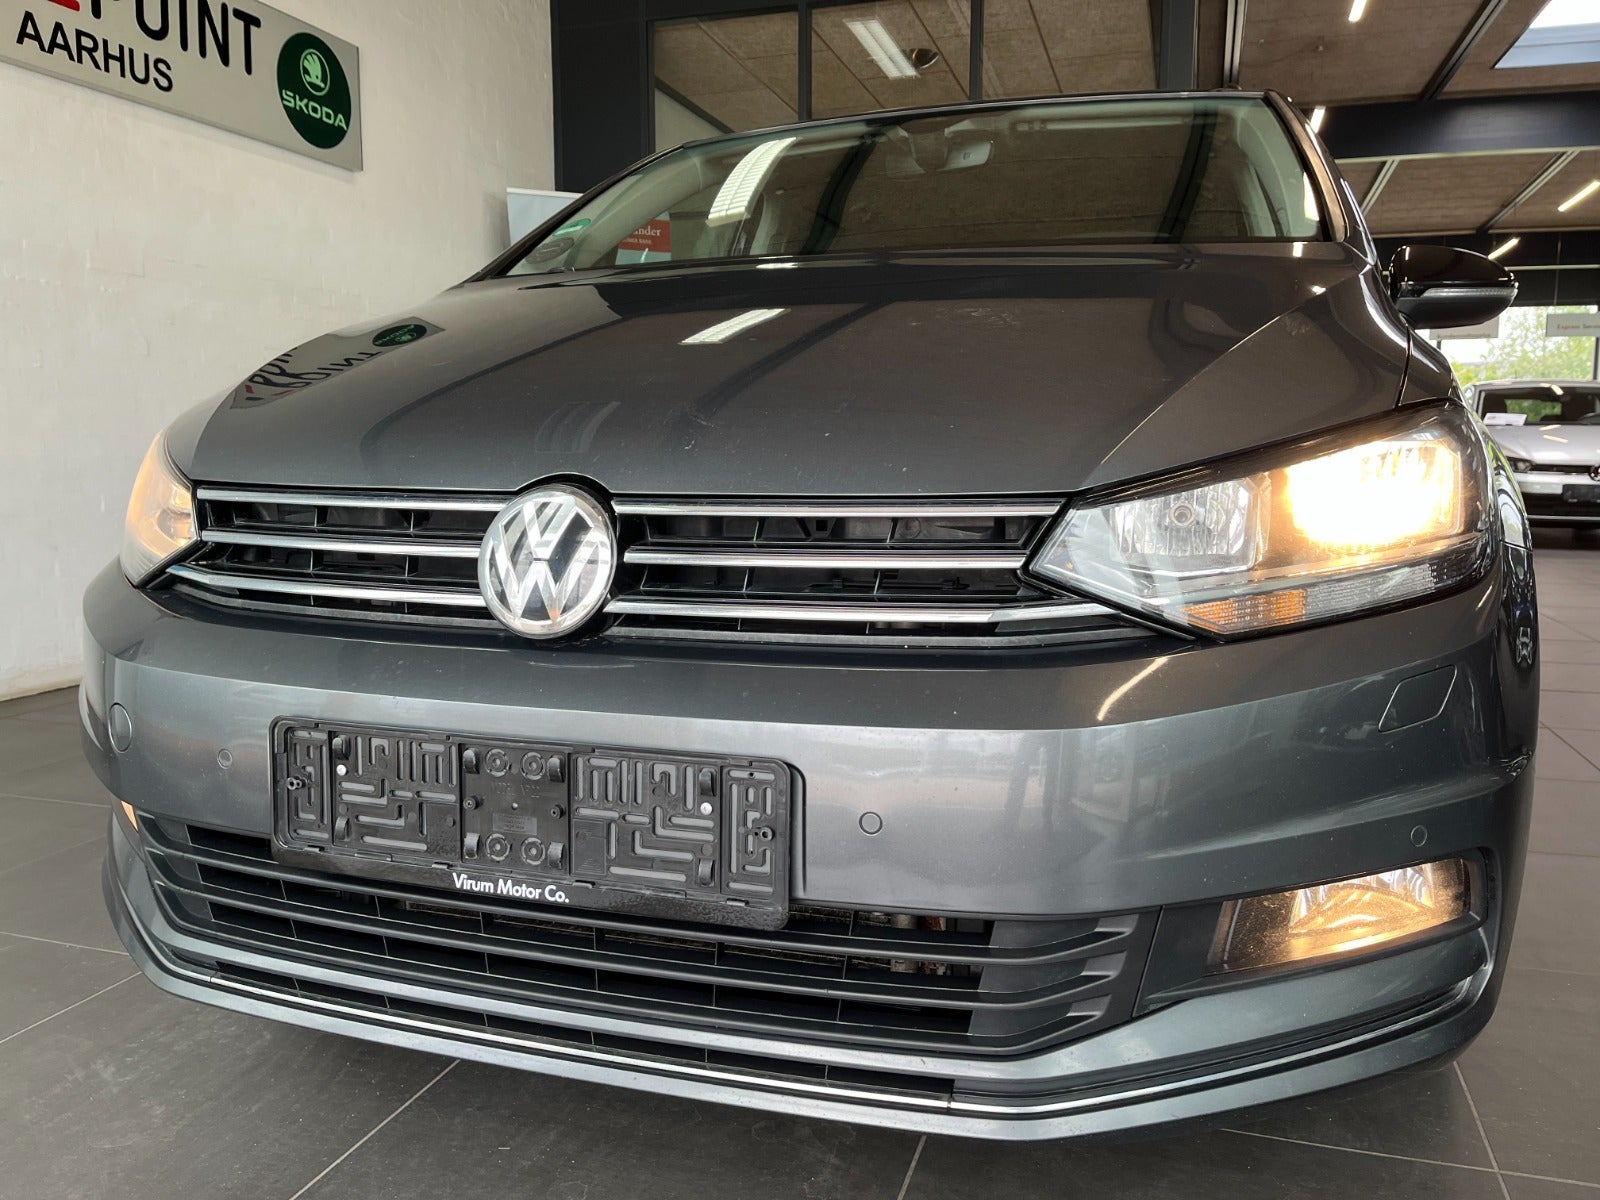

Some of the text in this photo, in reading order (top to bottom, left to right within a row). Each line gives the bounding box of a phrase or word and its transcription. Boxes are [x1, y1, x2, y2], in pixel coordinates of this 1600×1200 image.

[16, 10, 173, 92] AARHUS
[452, 872, 570, 903] Virum Motor Co.
